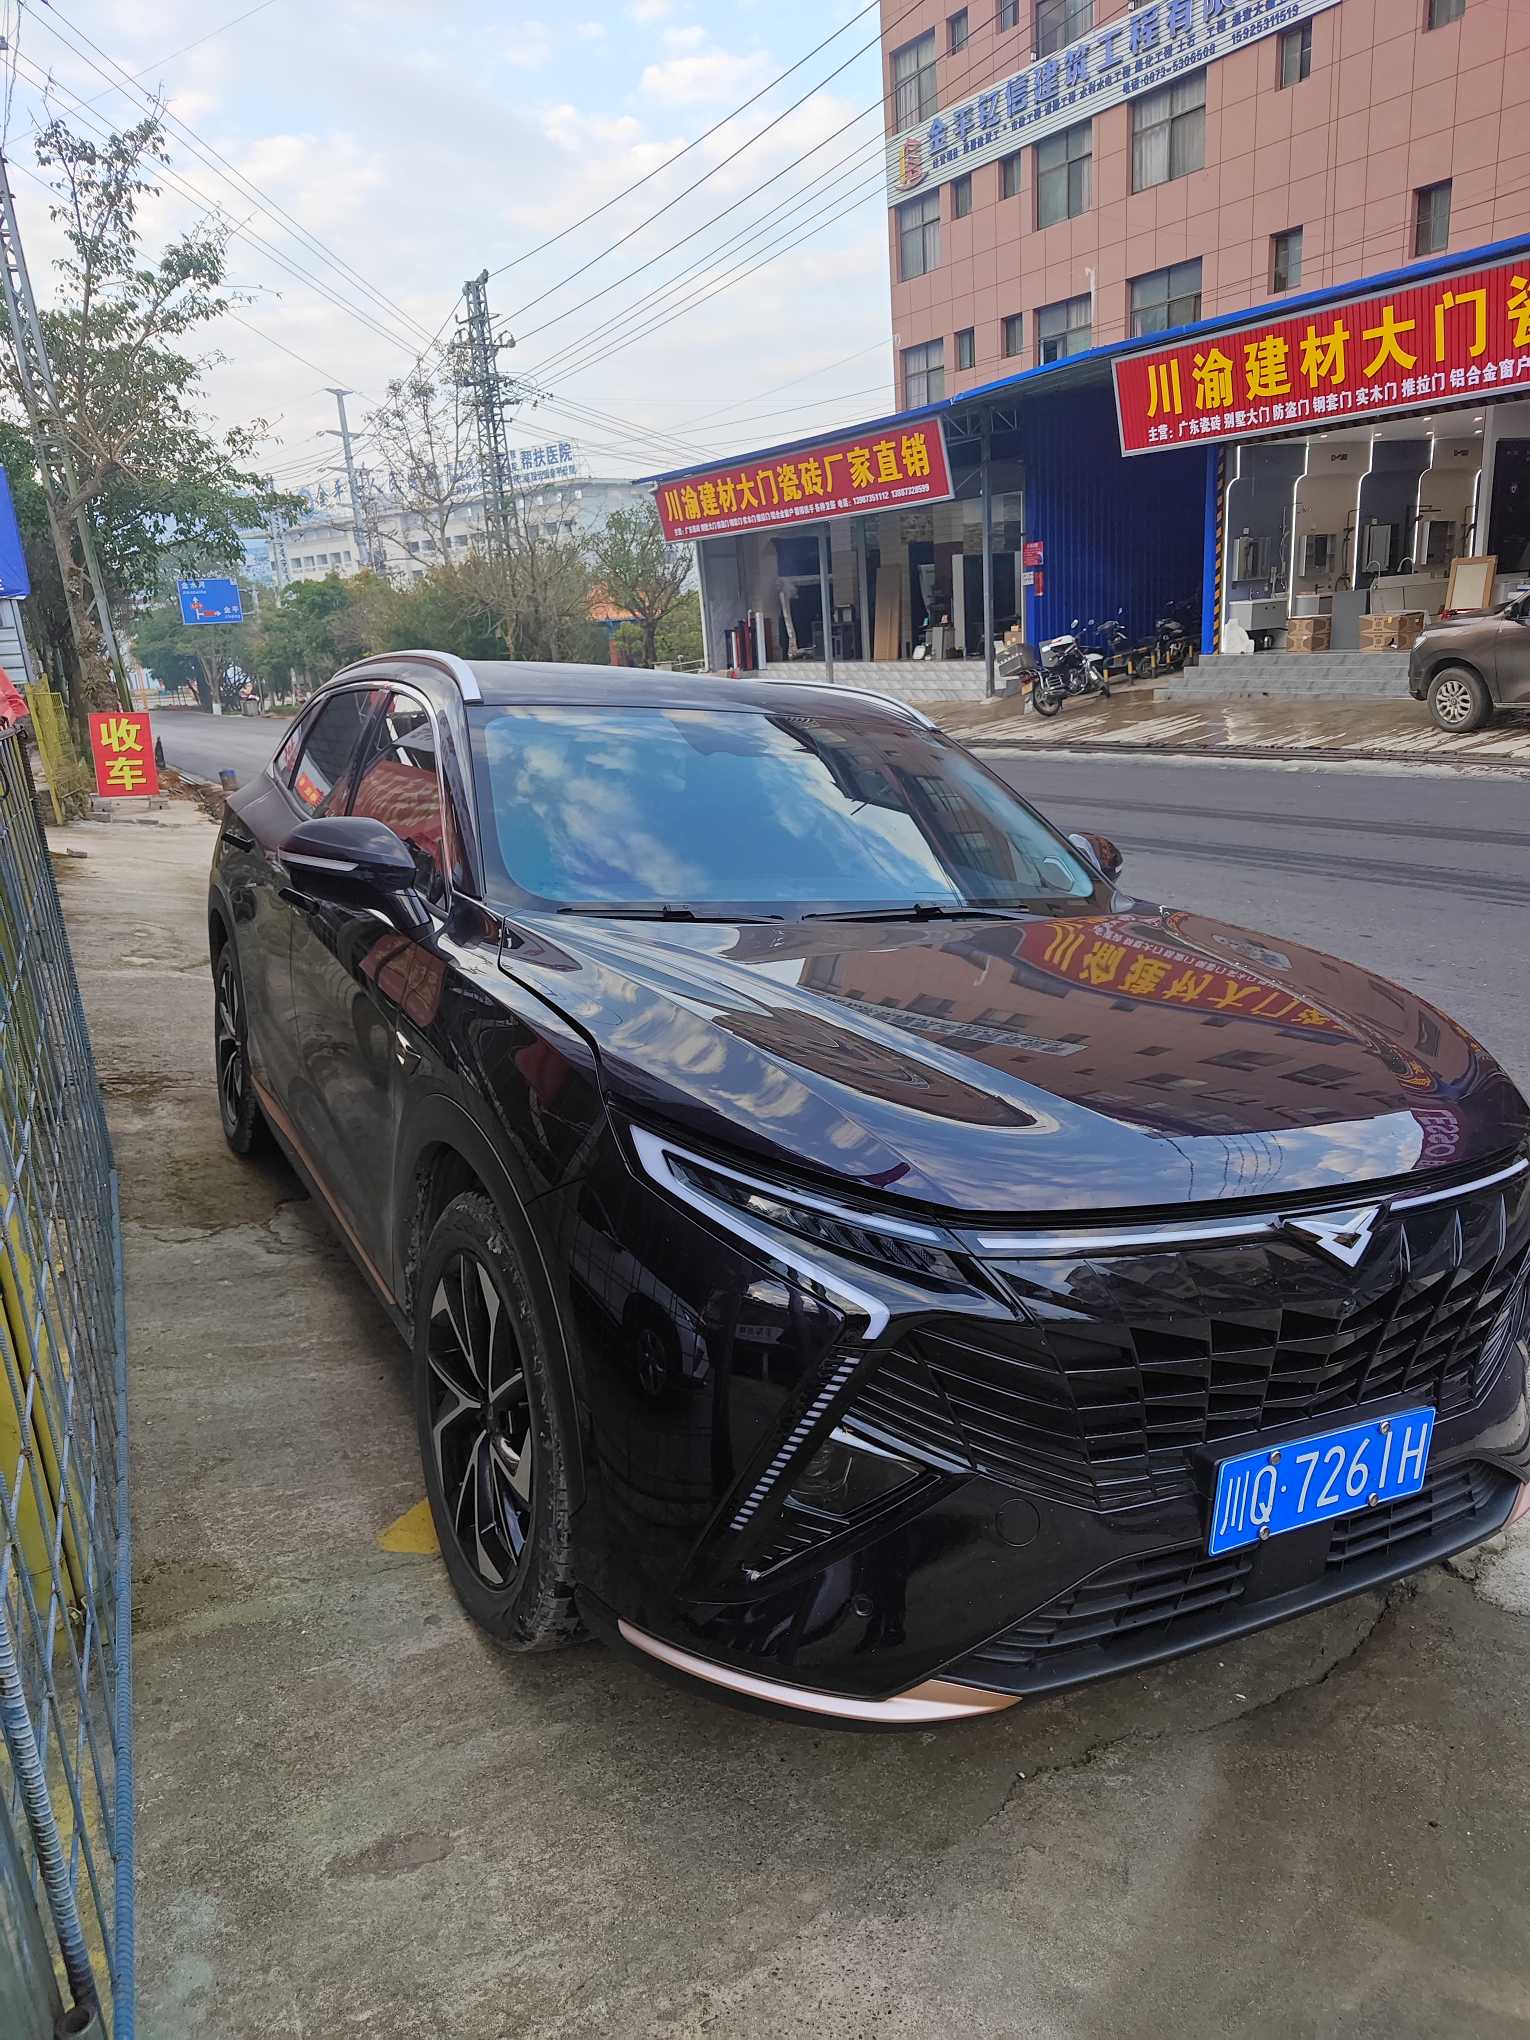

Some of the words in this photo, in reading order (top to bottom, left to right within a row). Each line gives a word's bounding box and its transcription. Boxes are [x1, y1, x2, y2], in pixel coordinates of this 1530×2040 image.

[1223, 406, 1270, 429] 别墅大门
[1273, 399, 1310, 421] 防盗门
[1312, 390, 1352, 414] 钢套门
[1356, 382, 1397, 406] 实木门
[1401, 373, 1446, 397] 推拉门
[664, 432, 930, 522] 川渝建材大门瓷砖厂家直销
[100, 717, 147, 791] 收车
[1220, 1423, 1428, 1535] 川Q·7261H
